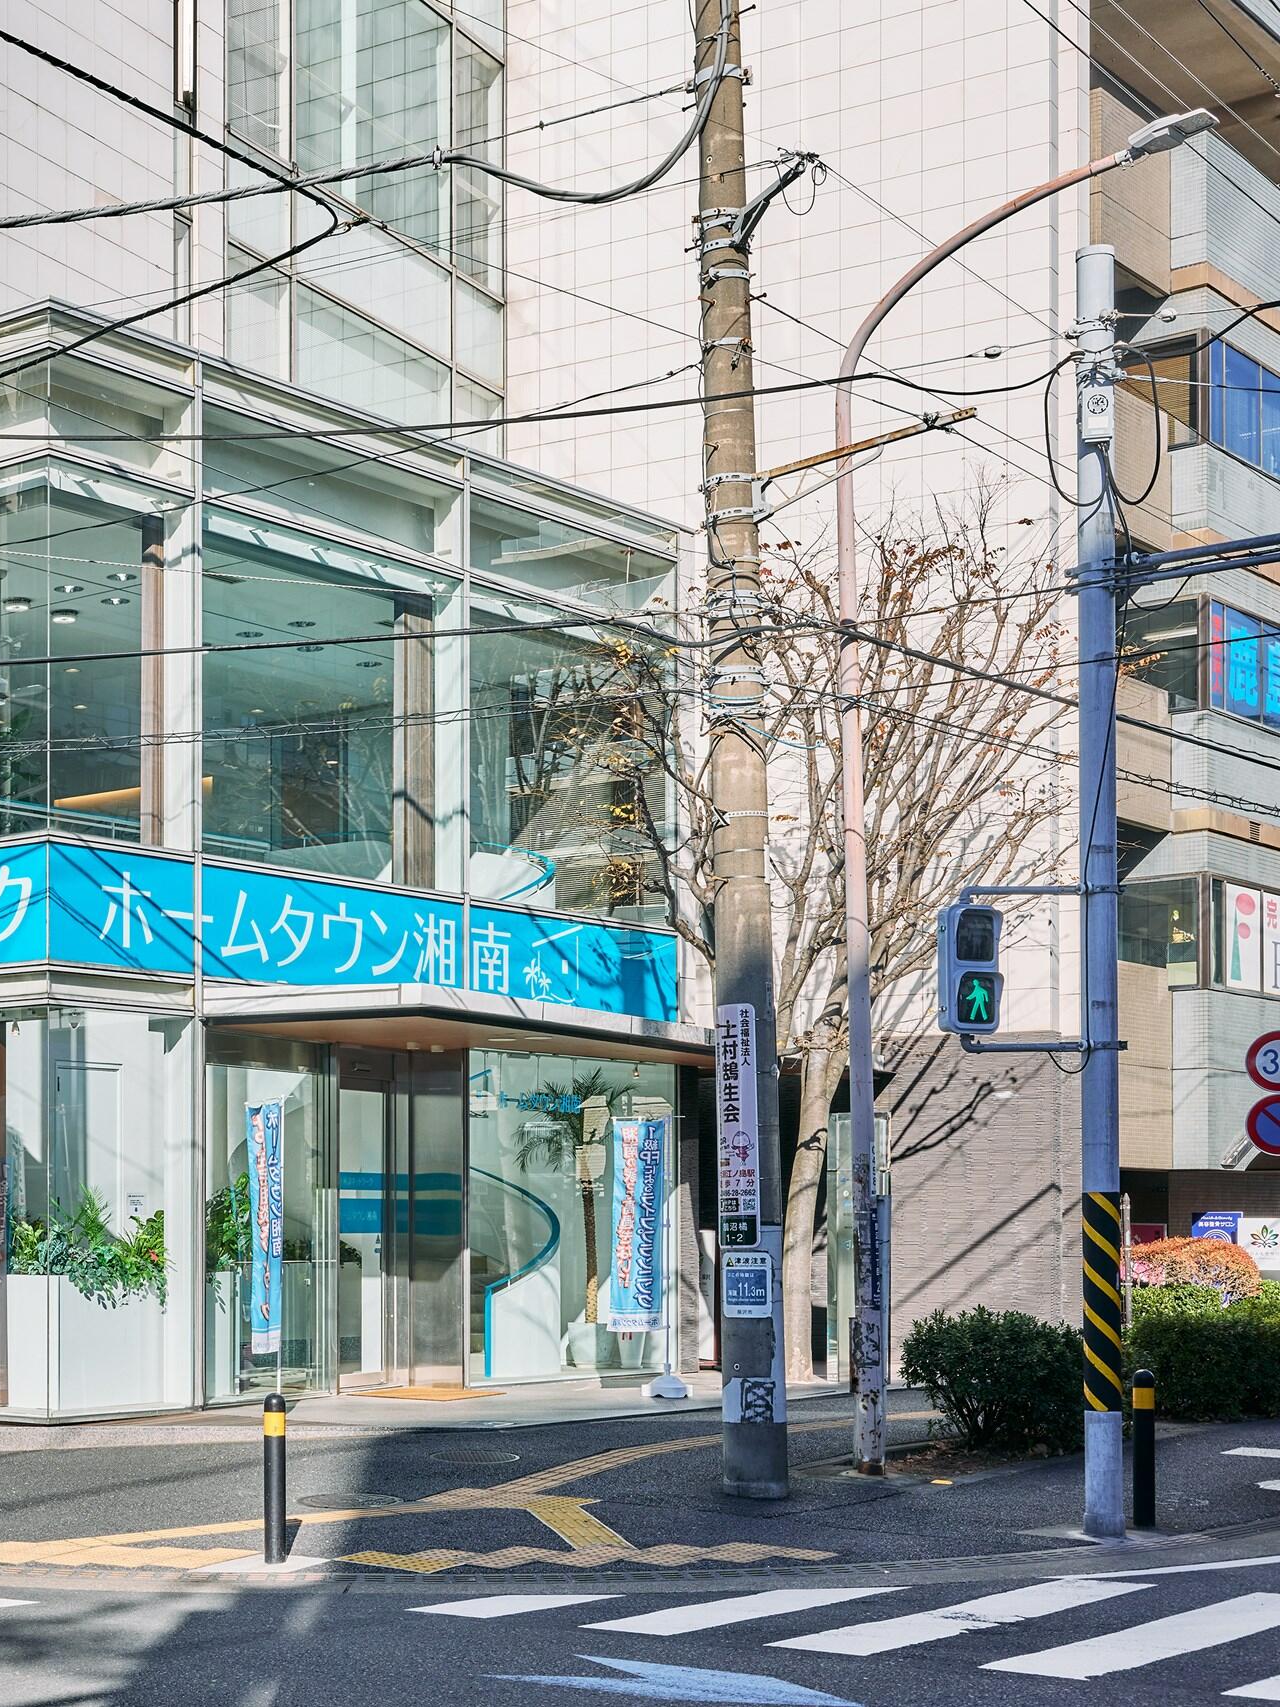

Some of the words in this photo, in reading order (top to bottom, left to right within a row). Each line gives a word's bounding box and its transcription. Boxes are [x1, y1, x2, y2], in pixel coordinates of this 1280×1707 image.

[99, 871, 510, 995] ホームタウン湘南
[740, 1009, 751, 1066] 社会福祉法人
[726, 1233, 743, 1242] 1-2
[735, 1256, 767, 1265] 津波注意
